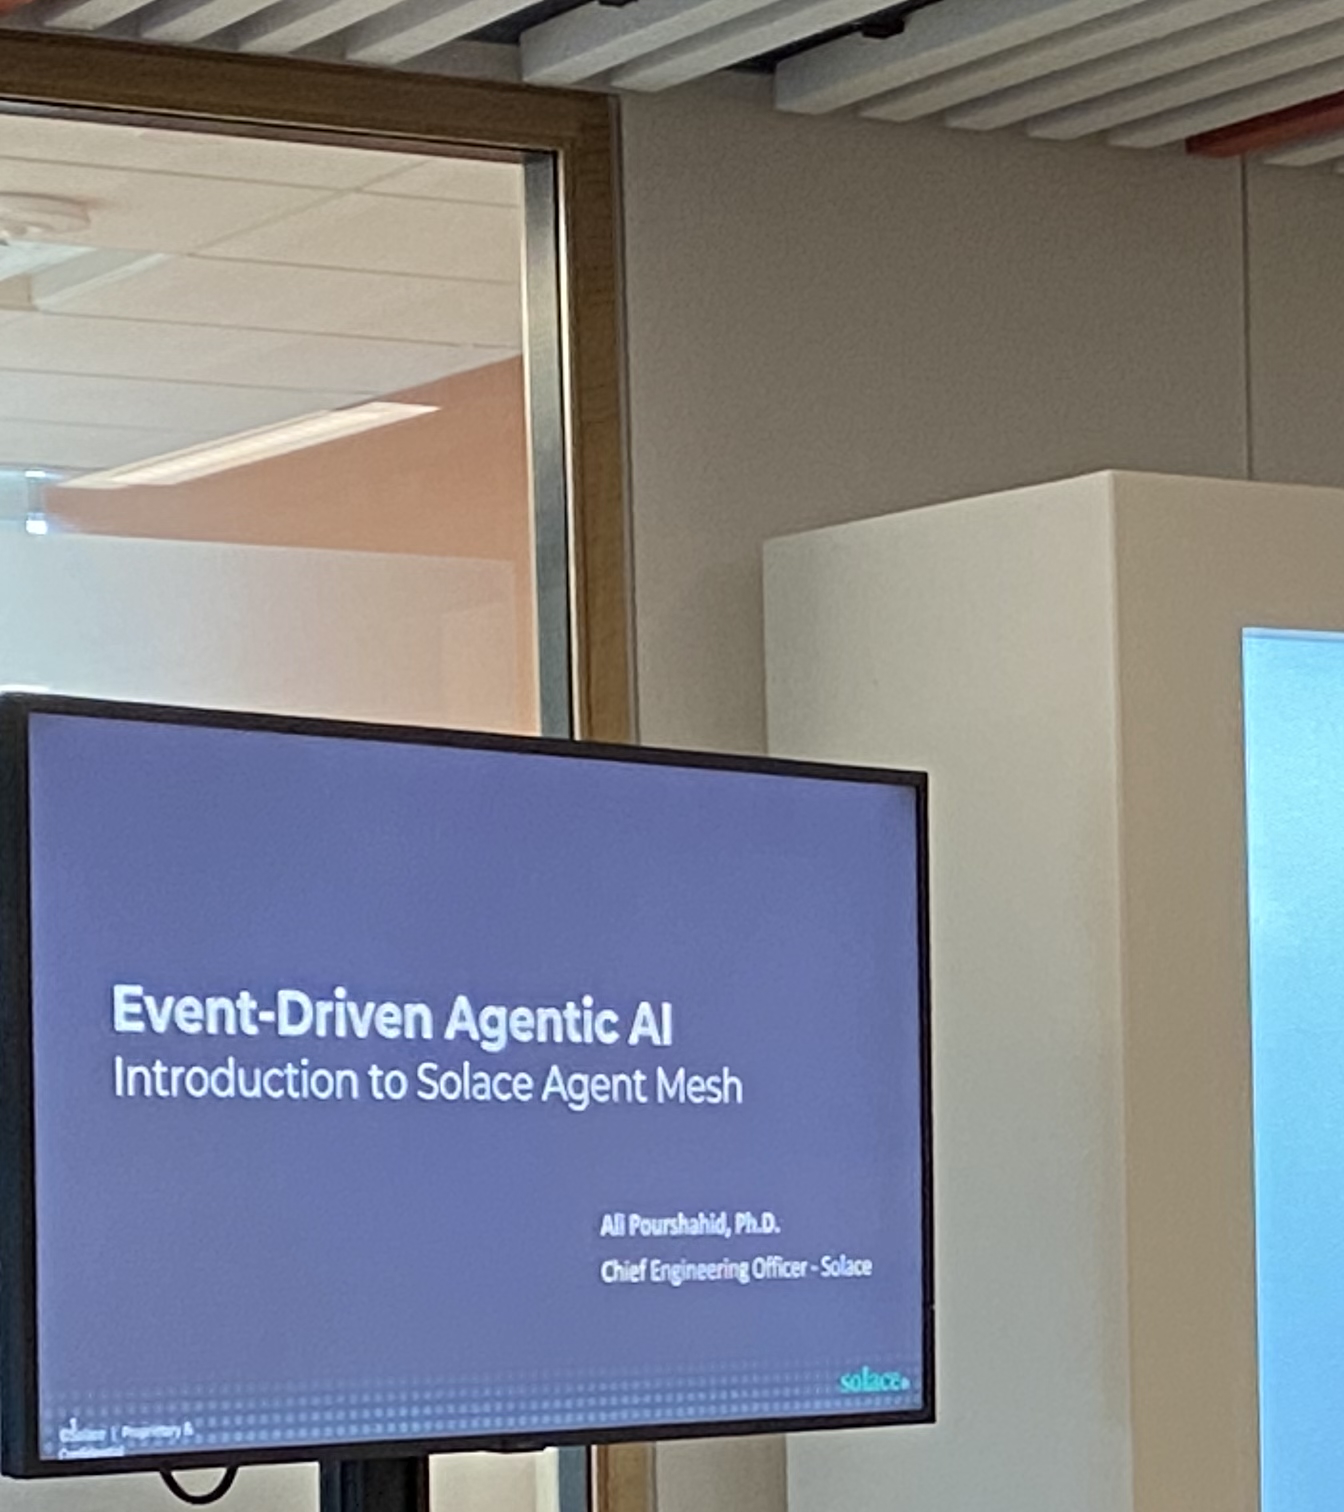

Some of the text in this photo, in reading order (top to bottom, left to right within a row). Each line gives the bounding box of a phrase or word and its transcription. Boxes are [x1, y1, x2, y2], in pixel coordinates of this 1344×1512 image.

[113, 983, 673, 1053] Event-Driven Agentic AI
[114, 1055, 744, 1112] Introduction to Solace Agent Mesh
[599, 1211, 782, 1239] Ali Pourshahid, Ph.D.
[600, 1257, 648, 1283] Chief
[650, 1257, 750, 1288] Engineering
[752, 1255, 808, 1280] Officer
[820, 1254, 873, 1278] Solace
